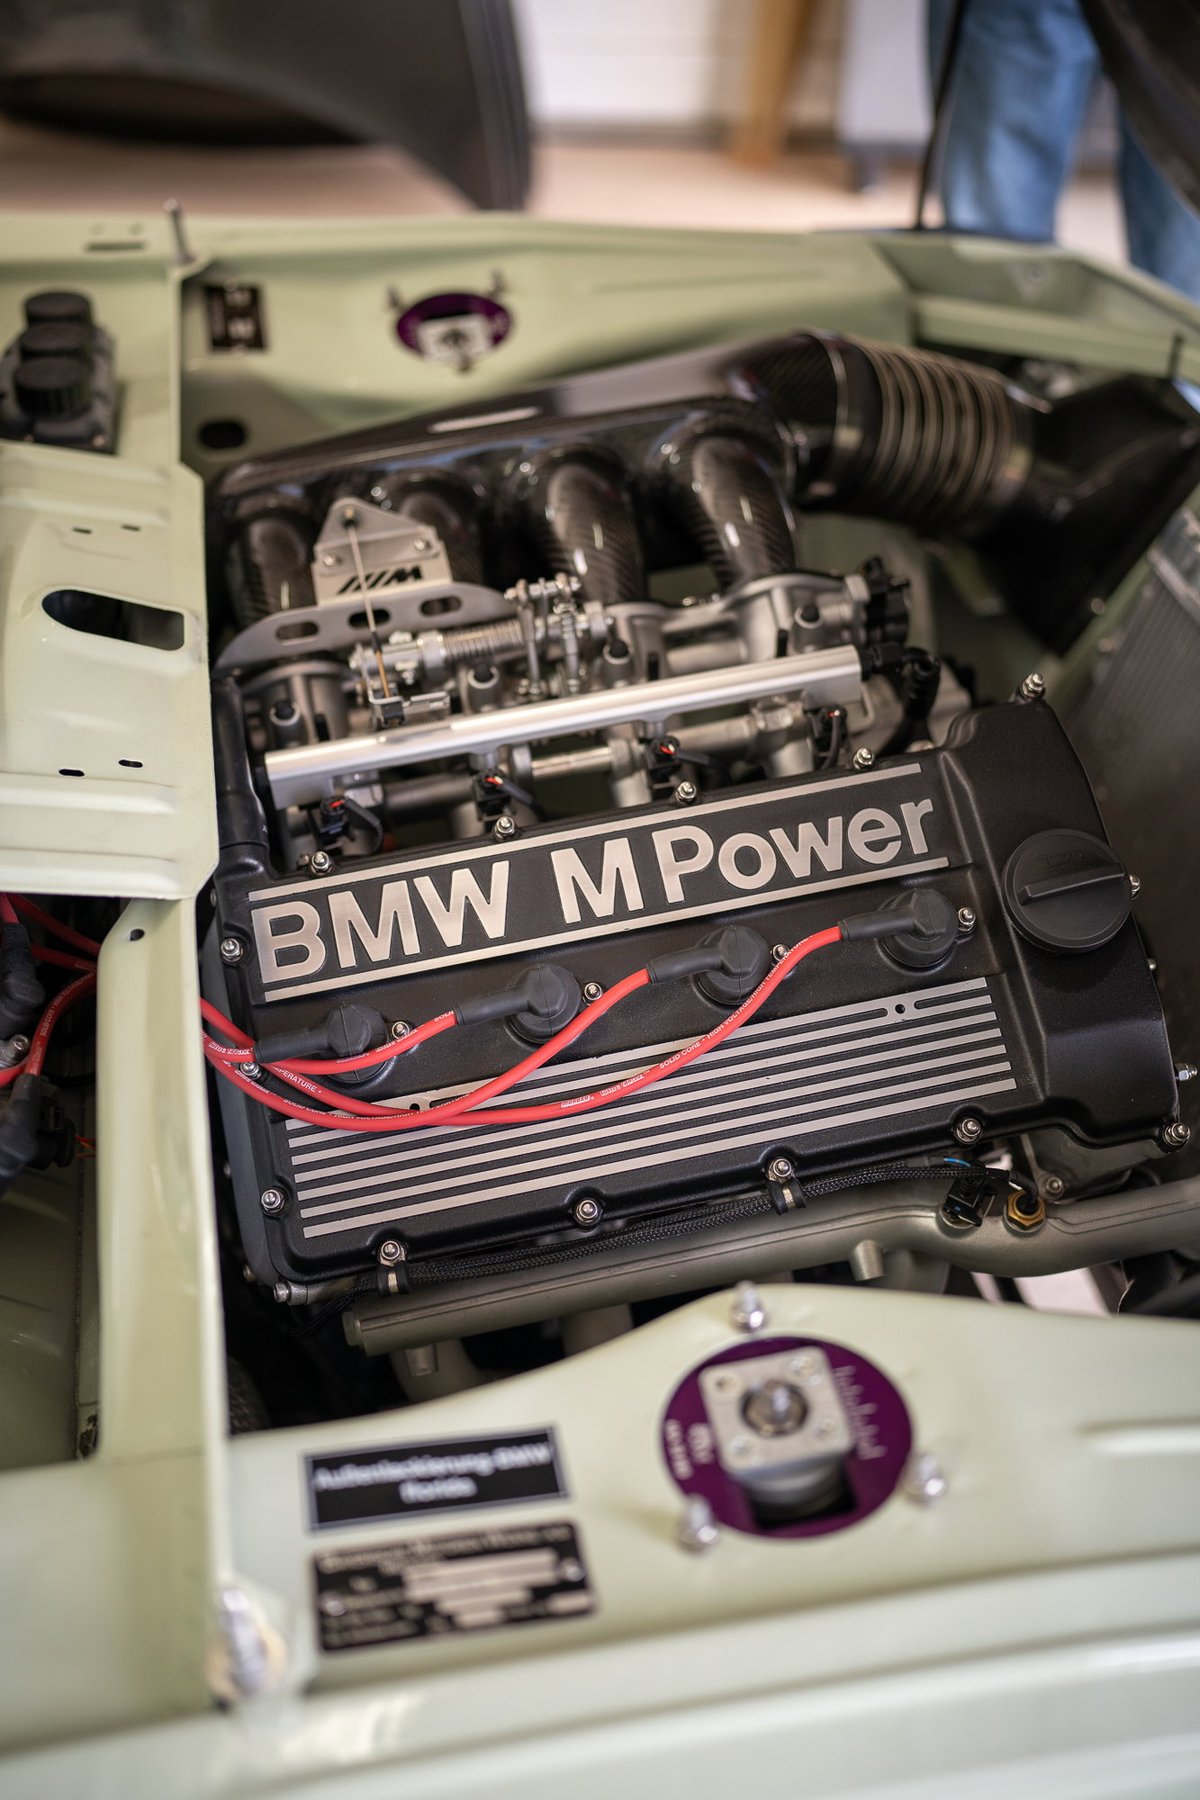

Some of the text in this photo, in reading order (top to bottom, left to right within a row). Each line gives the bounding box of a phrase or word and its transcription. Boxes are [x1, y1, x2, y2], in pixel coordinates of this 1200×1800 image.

[250, 860, 510, 983] BMW
[658, 1053, 681, 1069] SOLID
[680, 1040, 702, 1057] CORE
[706, 1025, 725, 1041] HIGH
